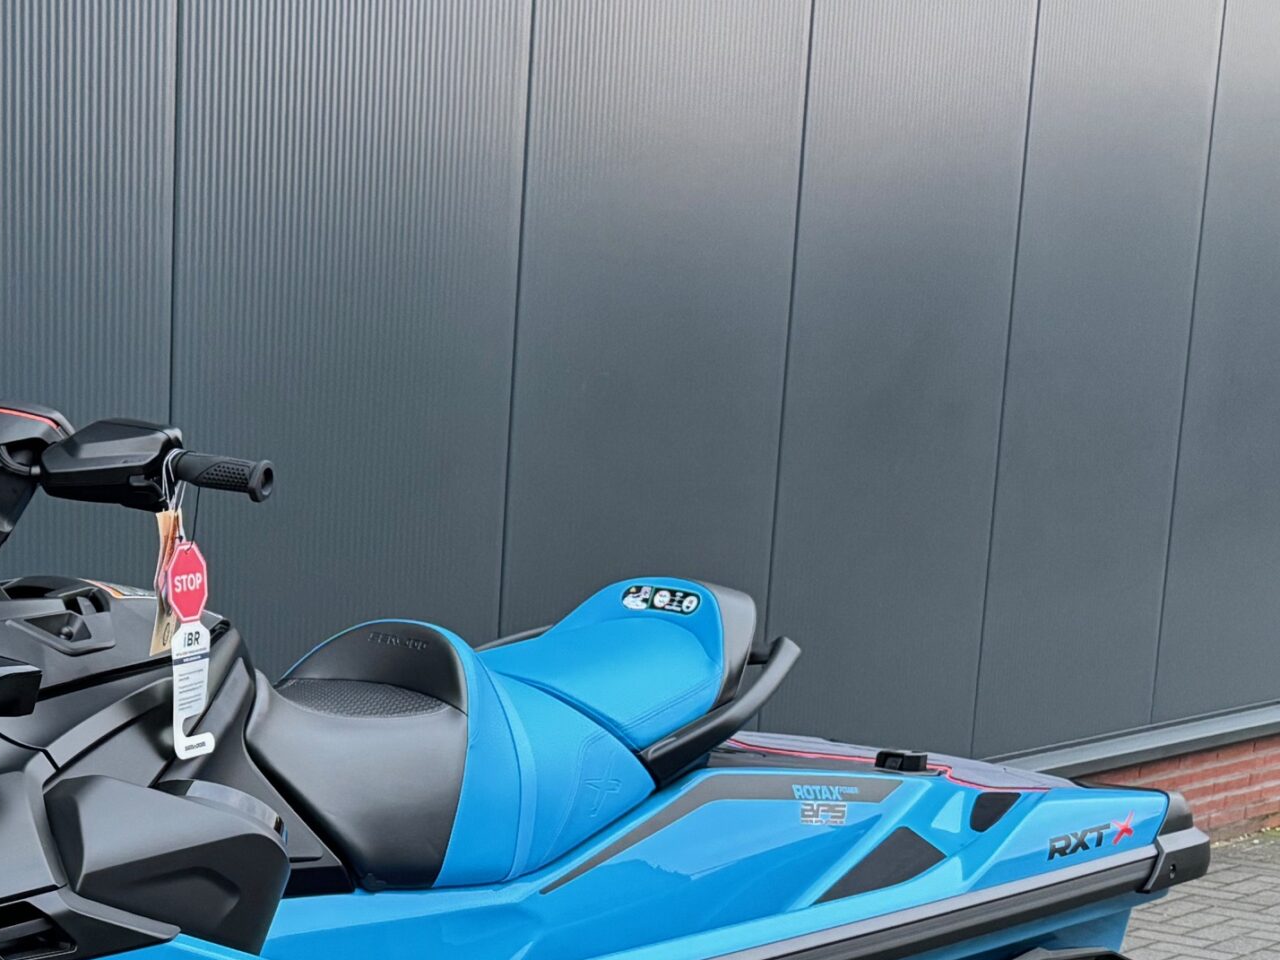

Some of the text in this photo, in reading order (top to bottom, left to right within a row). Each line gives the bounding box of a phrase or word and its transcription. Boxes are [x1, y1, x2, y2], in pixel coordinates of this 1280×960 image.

[174, 572, 203, 593] STOP
[792, 784, 843, 801] ROTAX
[1047, 823, 1112, 861] RXT
